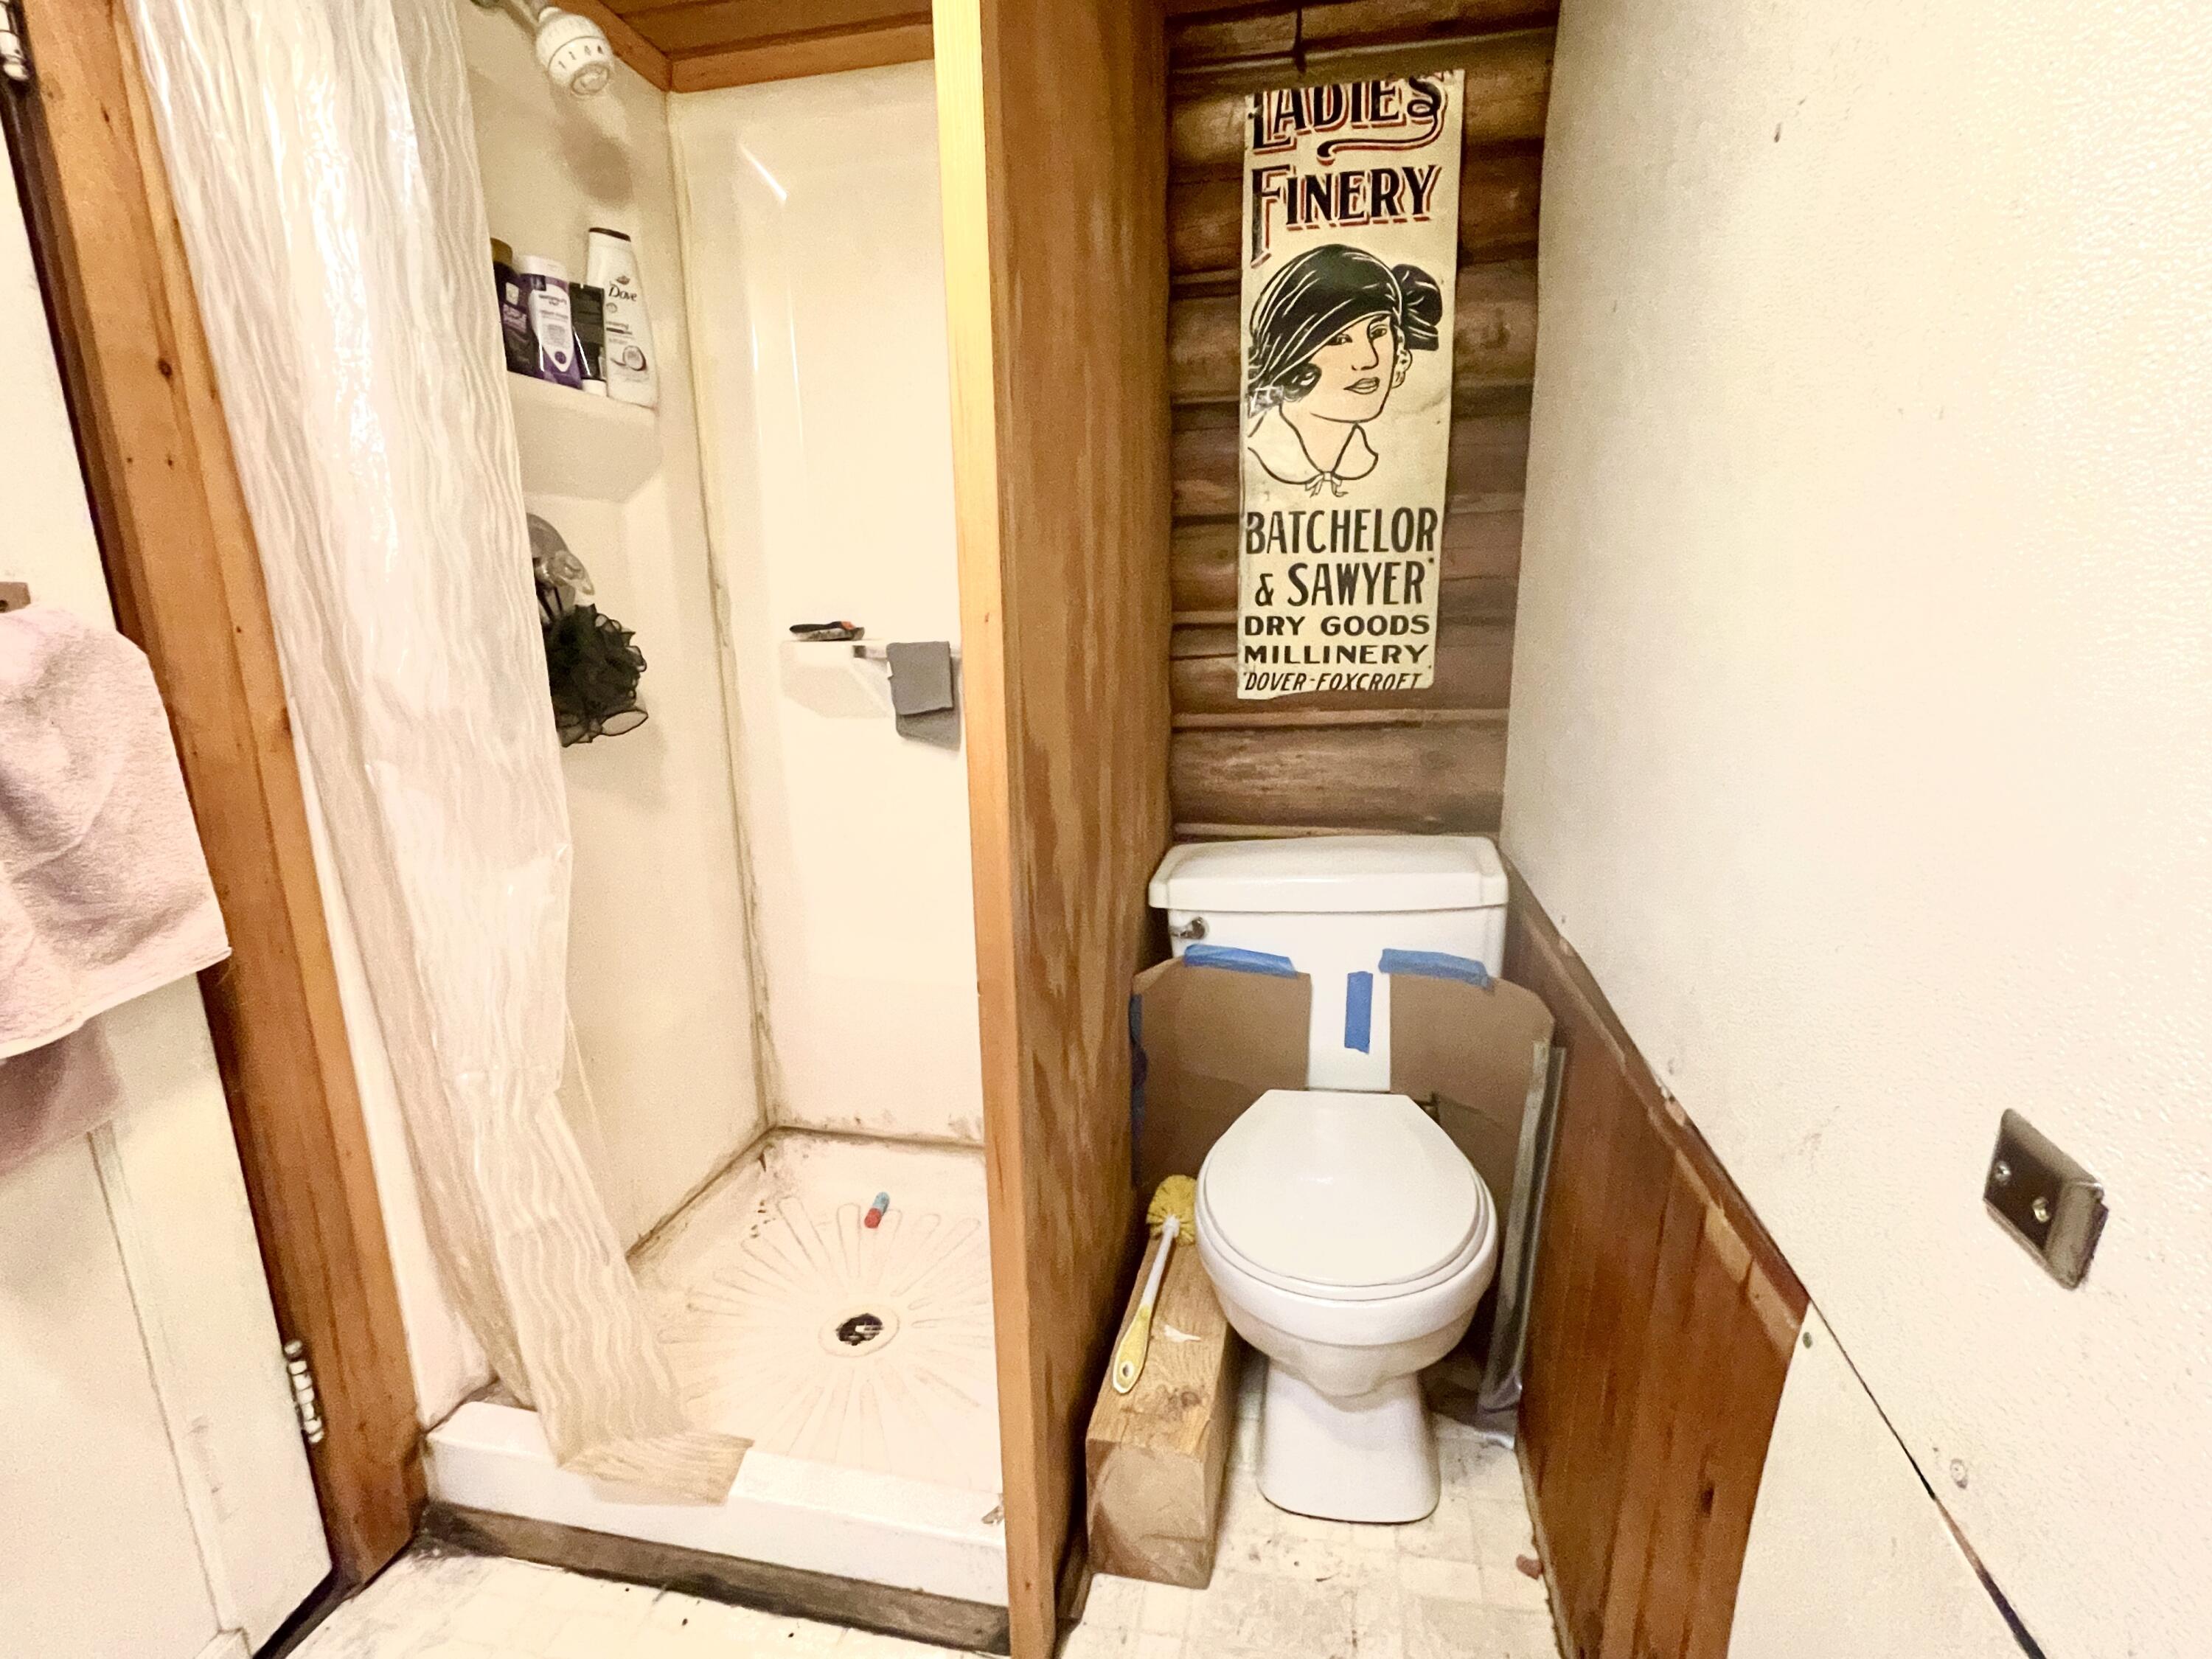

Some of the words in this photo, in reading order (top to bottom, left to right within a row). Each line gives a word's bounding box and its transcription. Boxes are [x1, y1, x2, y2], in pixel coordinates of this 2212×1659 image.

[1251, 164, 1442, 268] FINERY
[1245, 507, 1438, 554] BATCHELOR
[1255, 573, 1274, 607] &
[1287, 561, 1425, 607] SAWYER
[1244, 616, 1306, 636] DRY
[1321, 615, 1430, 636] GOODS
[1244, 644, 1428, 664] MILLINERY
[1245, 672, 1422, 692] DOVER-FOXCROFT
